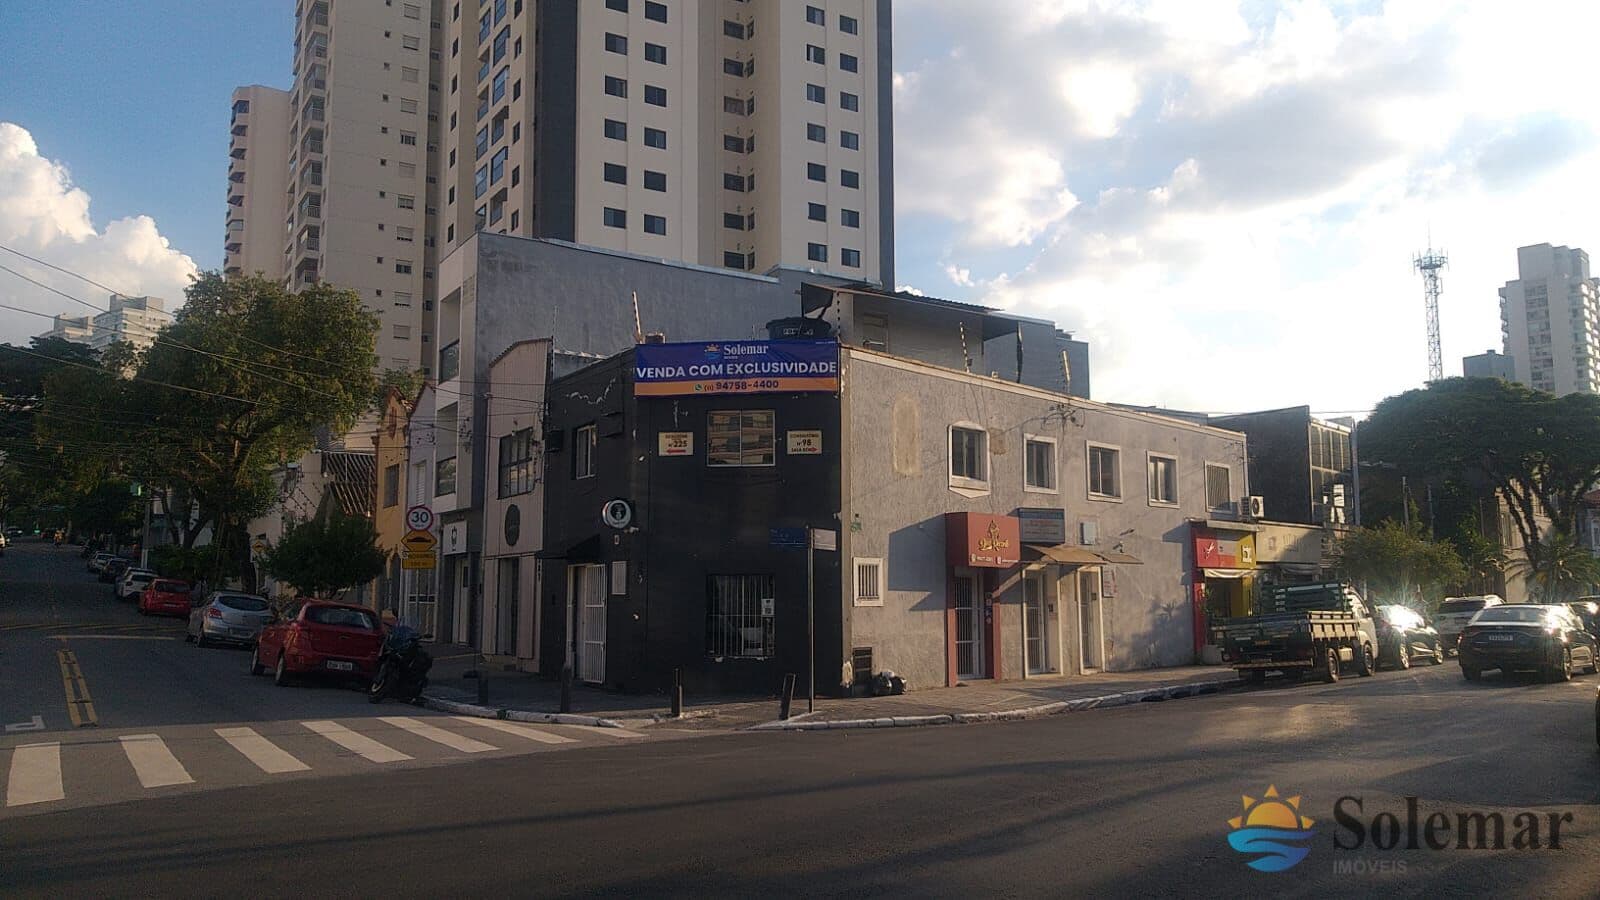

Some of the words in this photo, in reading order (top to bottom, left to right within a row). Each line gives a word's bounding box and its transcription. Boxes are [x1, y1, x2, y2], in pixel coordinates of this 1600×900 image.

[724, 344, 768, 355] Solemar
[636, 366, 685, 378] VENDA
[689, 364, 723, 376] COM
[727, 361, 836, 375] EXCLUSIVIDADE
[716, 380, 779, 391] 94758-4400
[411, 512, 429, 523] 30
